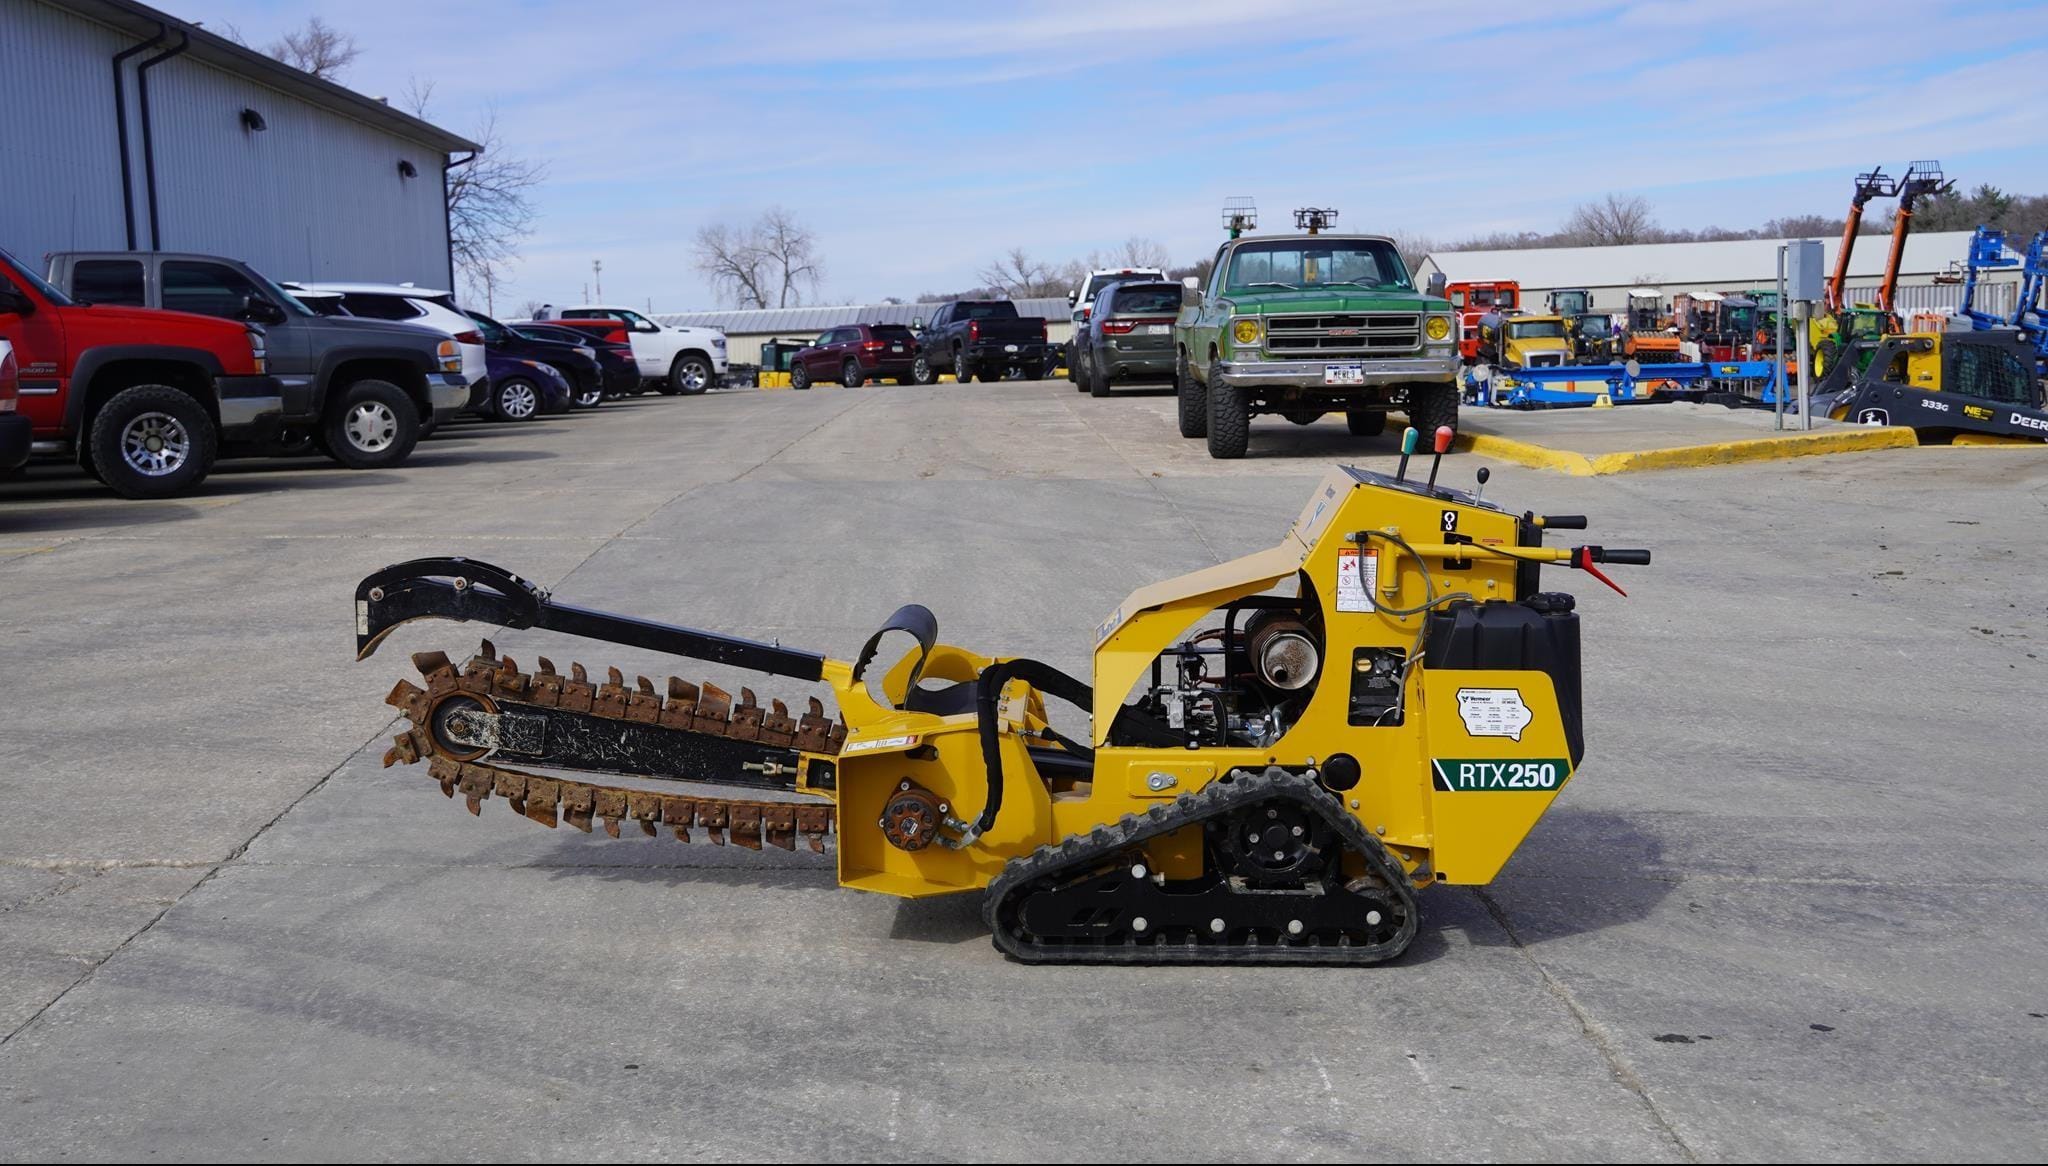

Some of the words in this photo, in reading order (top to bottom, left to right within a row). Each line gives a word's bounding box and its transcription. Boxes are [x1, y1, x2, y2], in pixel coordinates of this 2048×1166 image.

[1921, 399, 1949, 412] 333G
[1963, 405, 1982, 416] NE
[1460, 763, 1556, 788] RTX250
